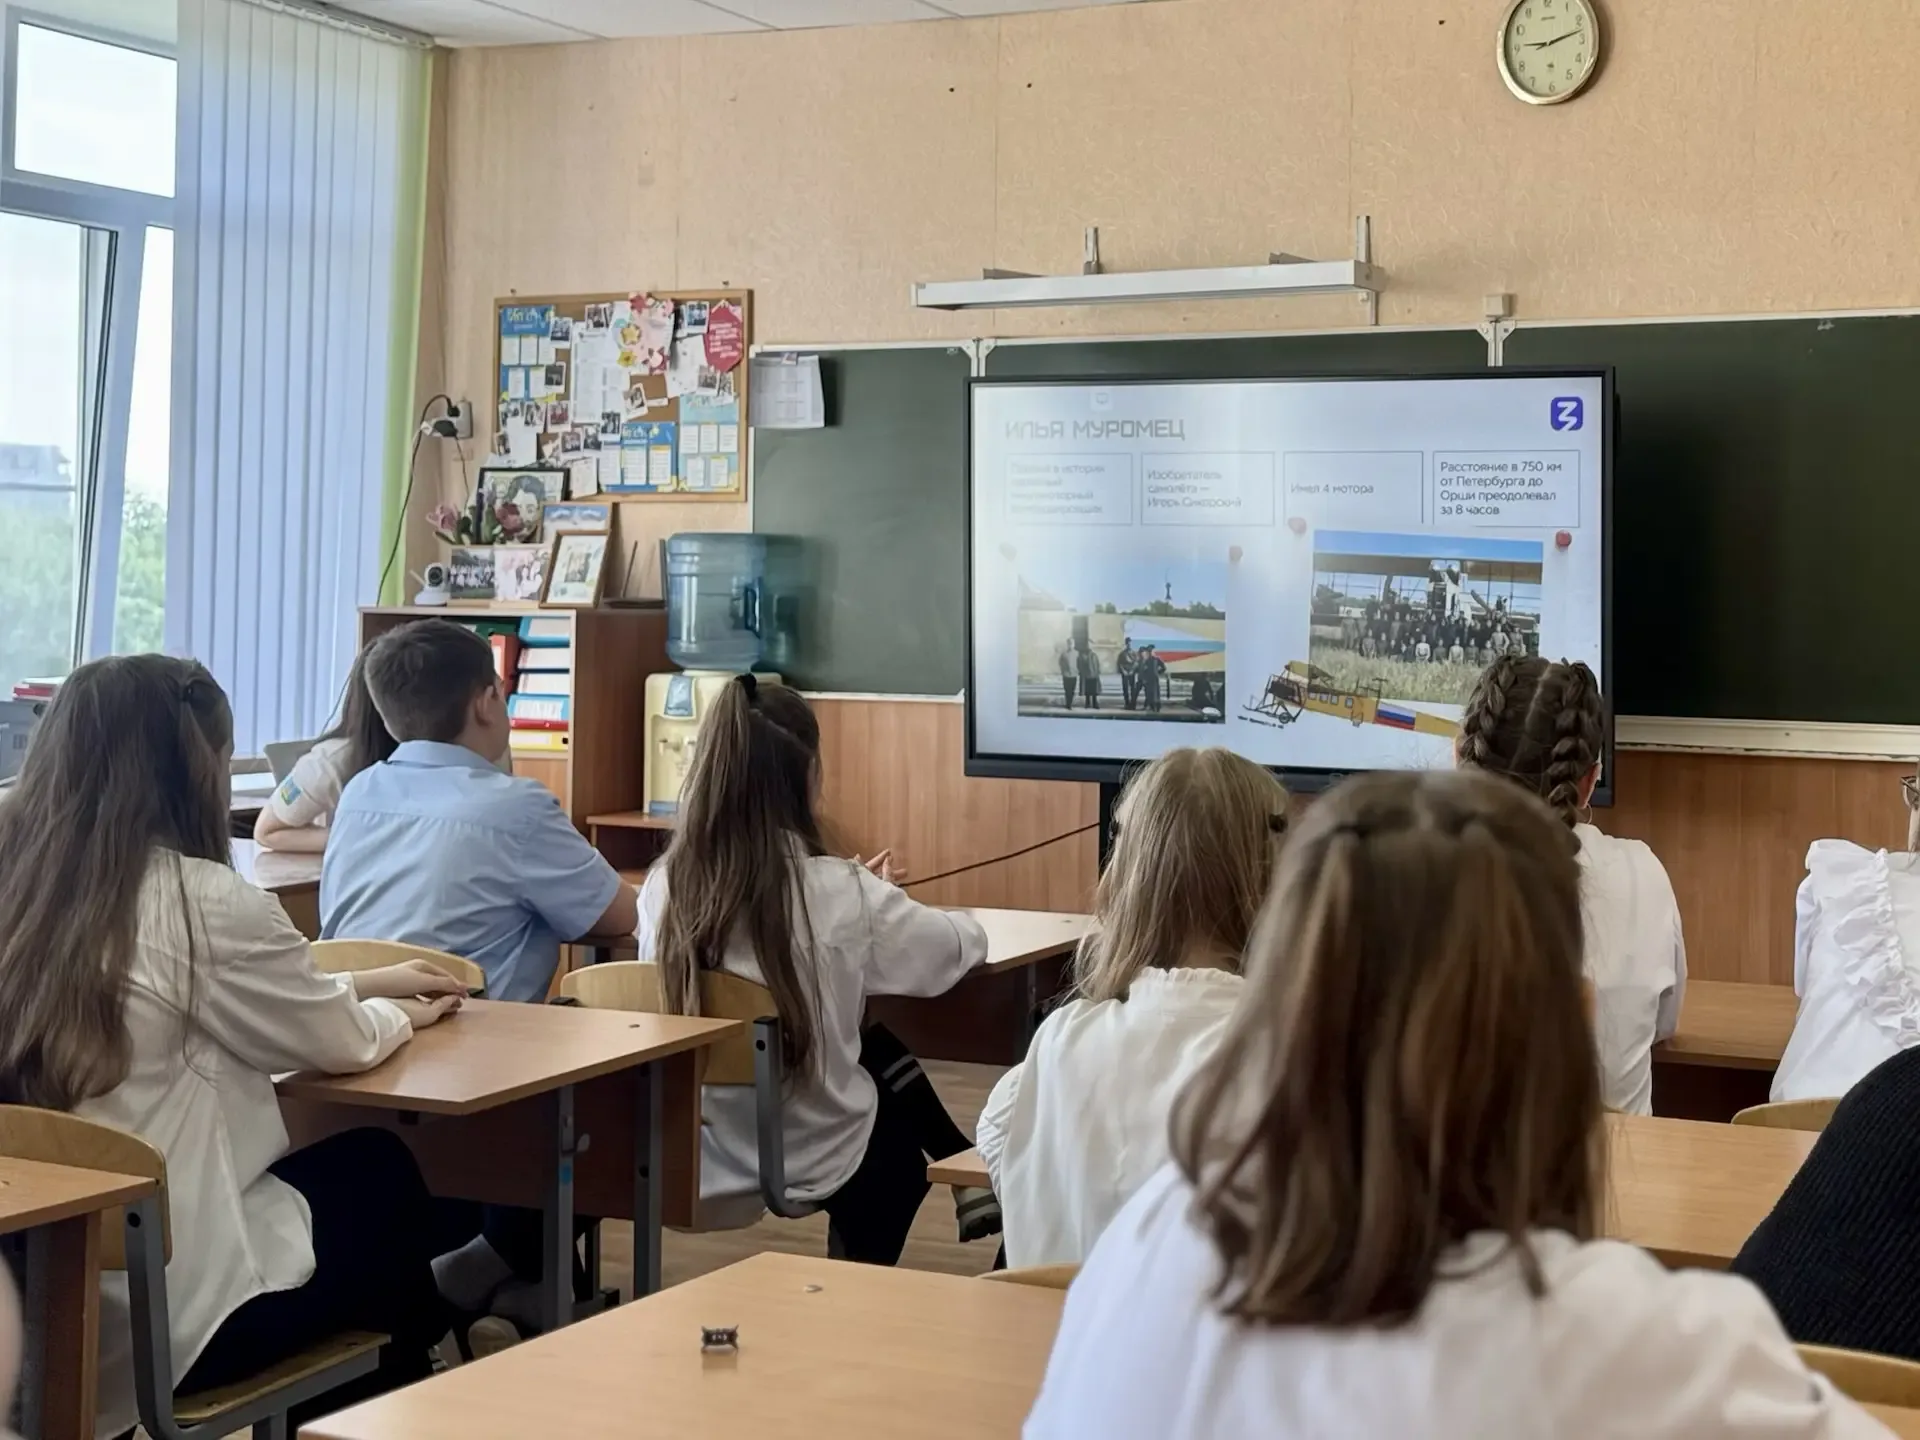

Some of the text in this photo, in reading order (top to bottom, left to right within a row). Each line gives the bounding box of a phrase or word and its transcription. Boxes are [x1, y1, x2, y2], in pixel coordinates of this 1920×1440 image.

[1516, 24, 1525, 36] 10
[1514, 44, 1520, 55] 9
[1575, 53, 1582, 63] 4
[1519, 61, 1525, 72] 8
[1566, 69, 1573, 80] 5
[1530, 76, 1536, 88] 7
[1549, 82, 1556, 92] 6
[1005, 419, 1185, 441] ИЛЬЯ МУРОМЕЦ
[1440, 461, 1562, 472] Расстояние в 750 км
[1147, 469, 1222, 480] Изобретатель
[1440, 476, 1543, 488] от Петербурга до
[1323, 483, 1330, 493] 4
[1332, 484, 1375, 495] мотора
[1440, 490, 1557, 502] Орши преодолевал
[1440, 504, 1500, 515] за 8 часов
